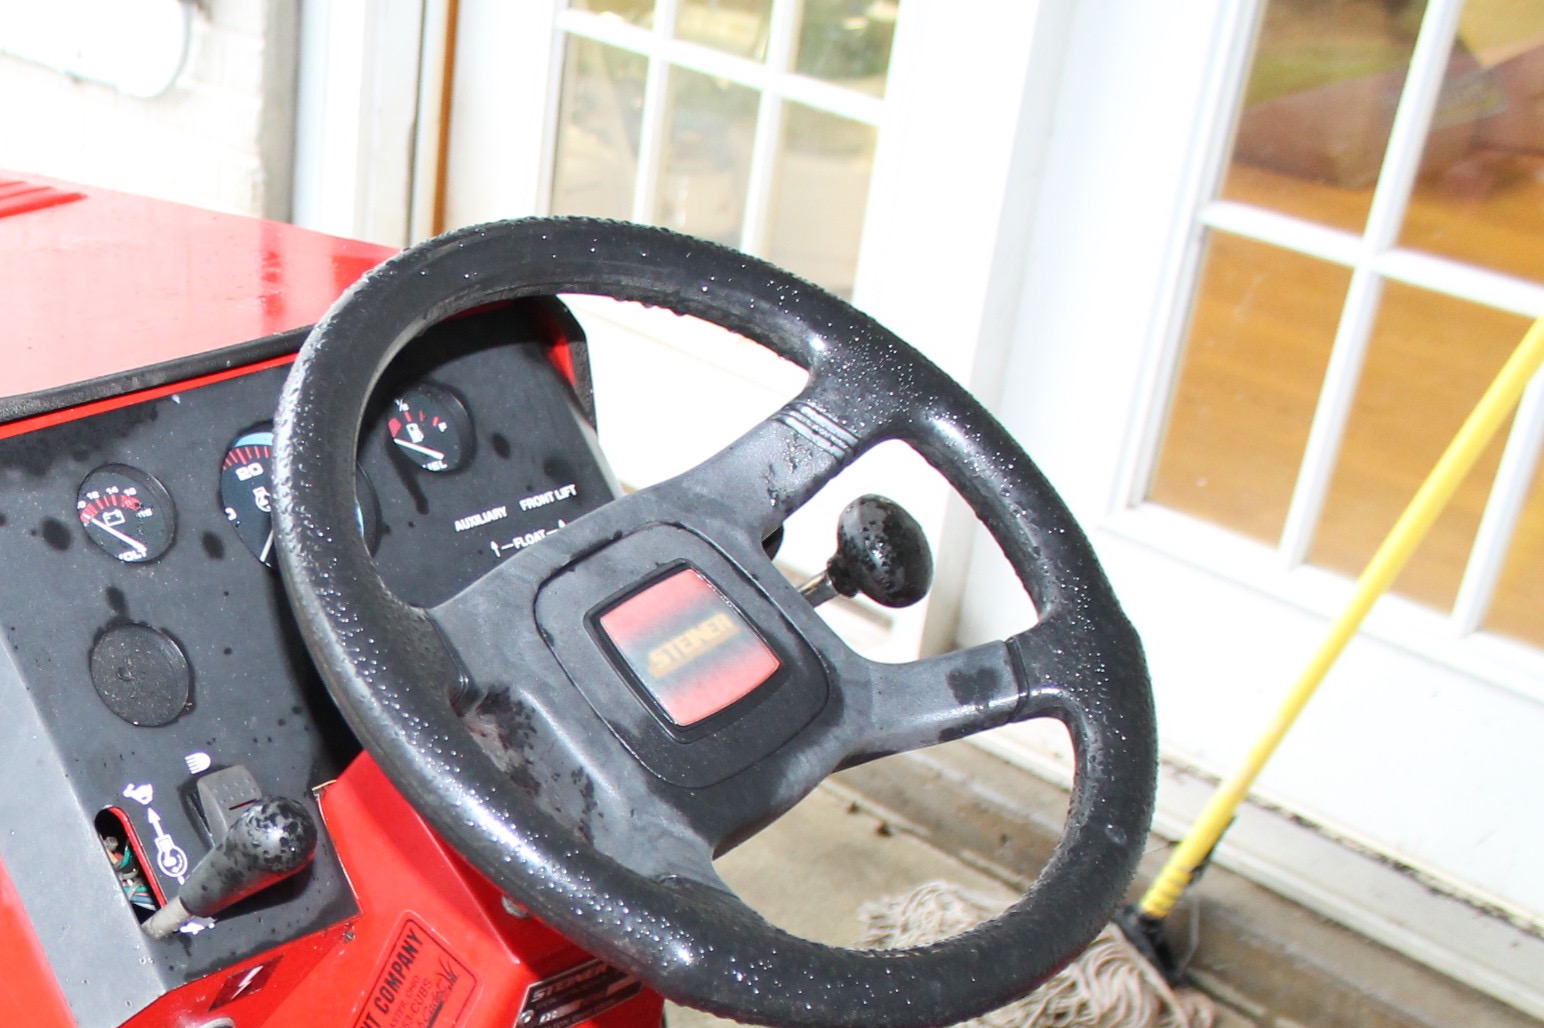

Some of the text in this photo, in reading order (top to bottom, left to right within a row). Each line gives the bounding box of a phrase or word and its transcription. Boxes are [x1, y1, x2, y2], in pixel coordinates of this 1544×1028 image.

[519, 484, 577, 511] FRONT LIFT
[454, 506, 507, 532] AUXILIARY
[512, 529, 546, 550] FLOAT
[649, 612, 740, 672] STEINER
[374, 927, 424, 1014] COMPANY
